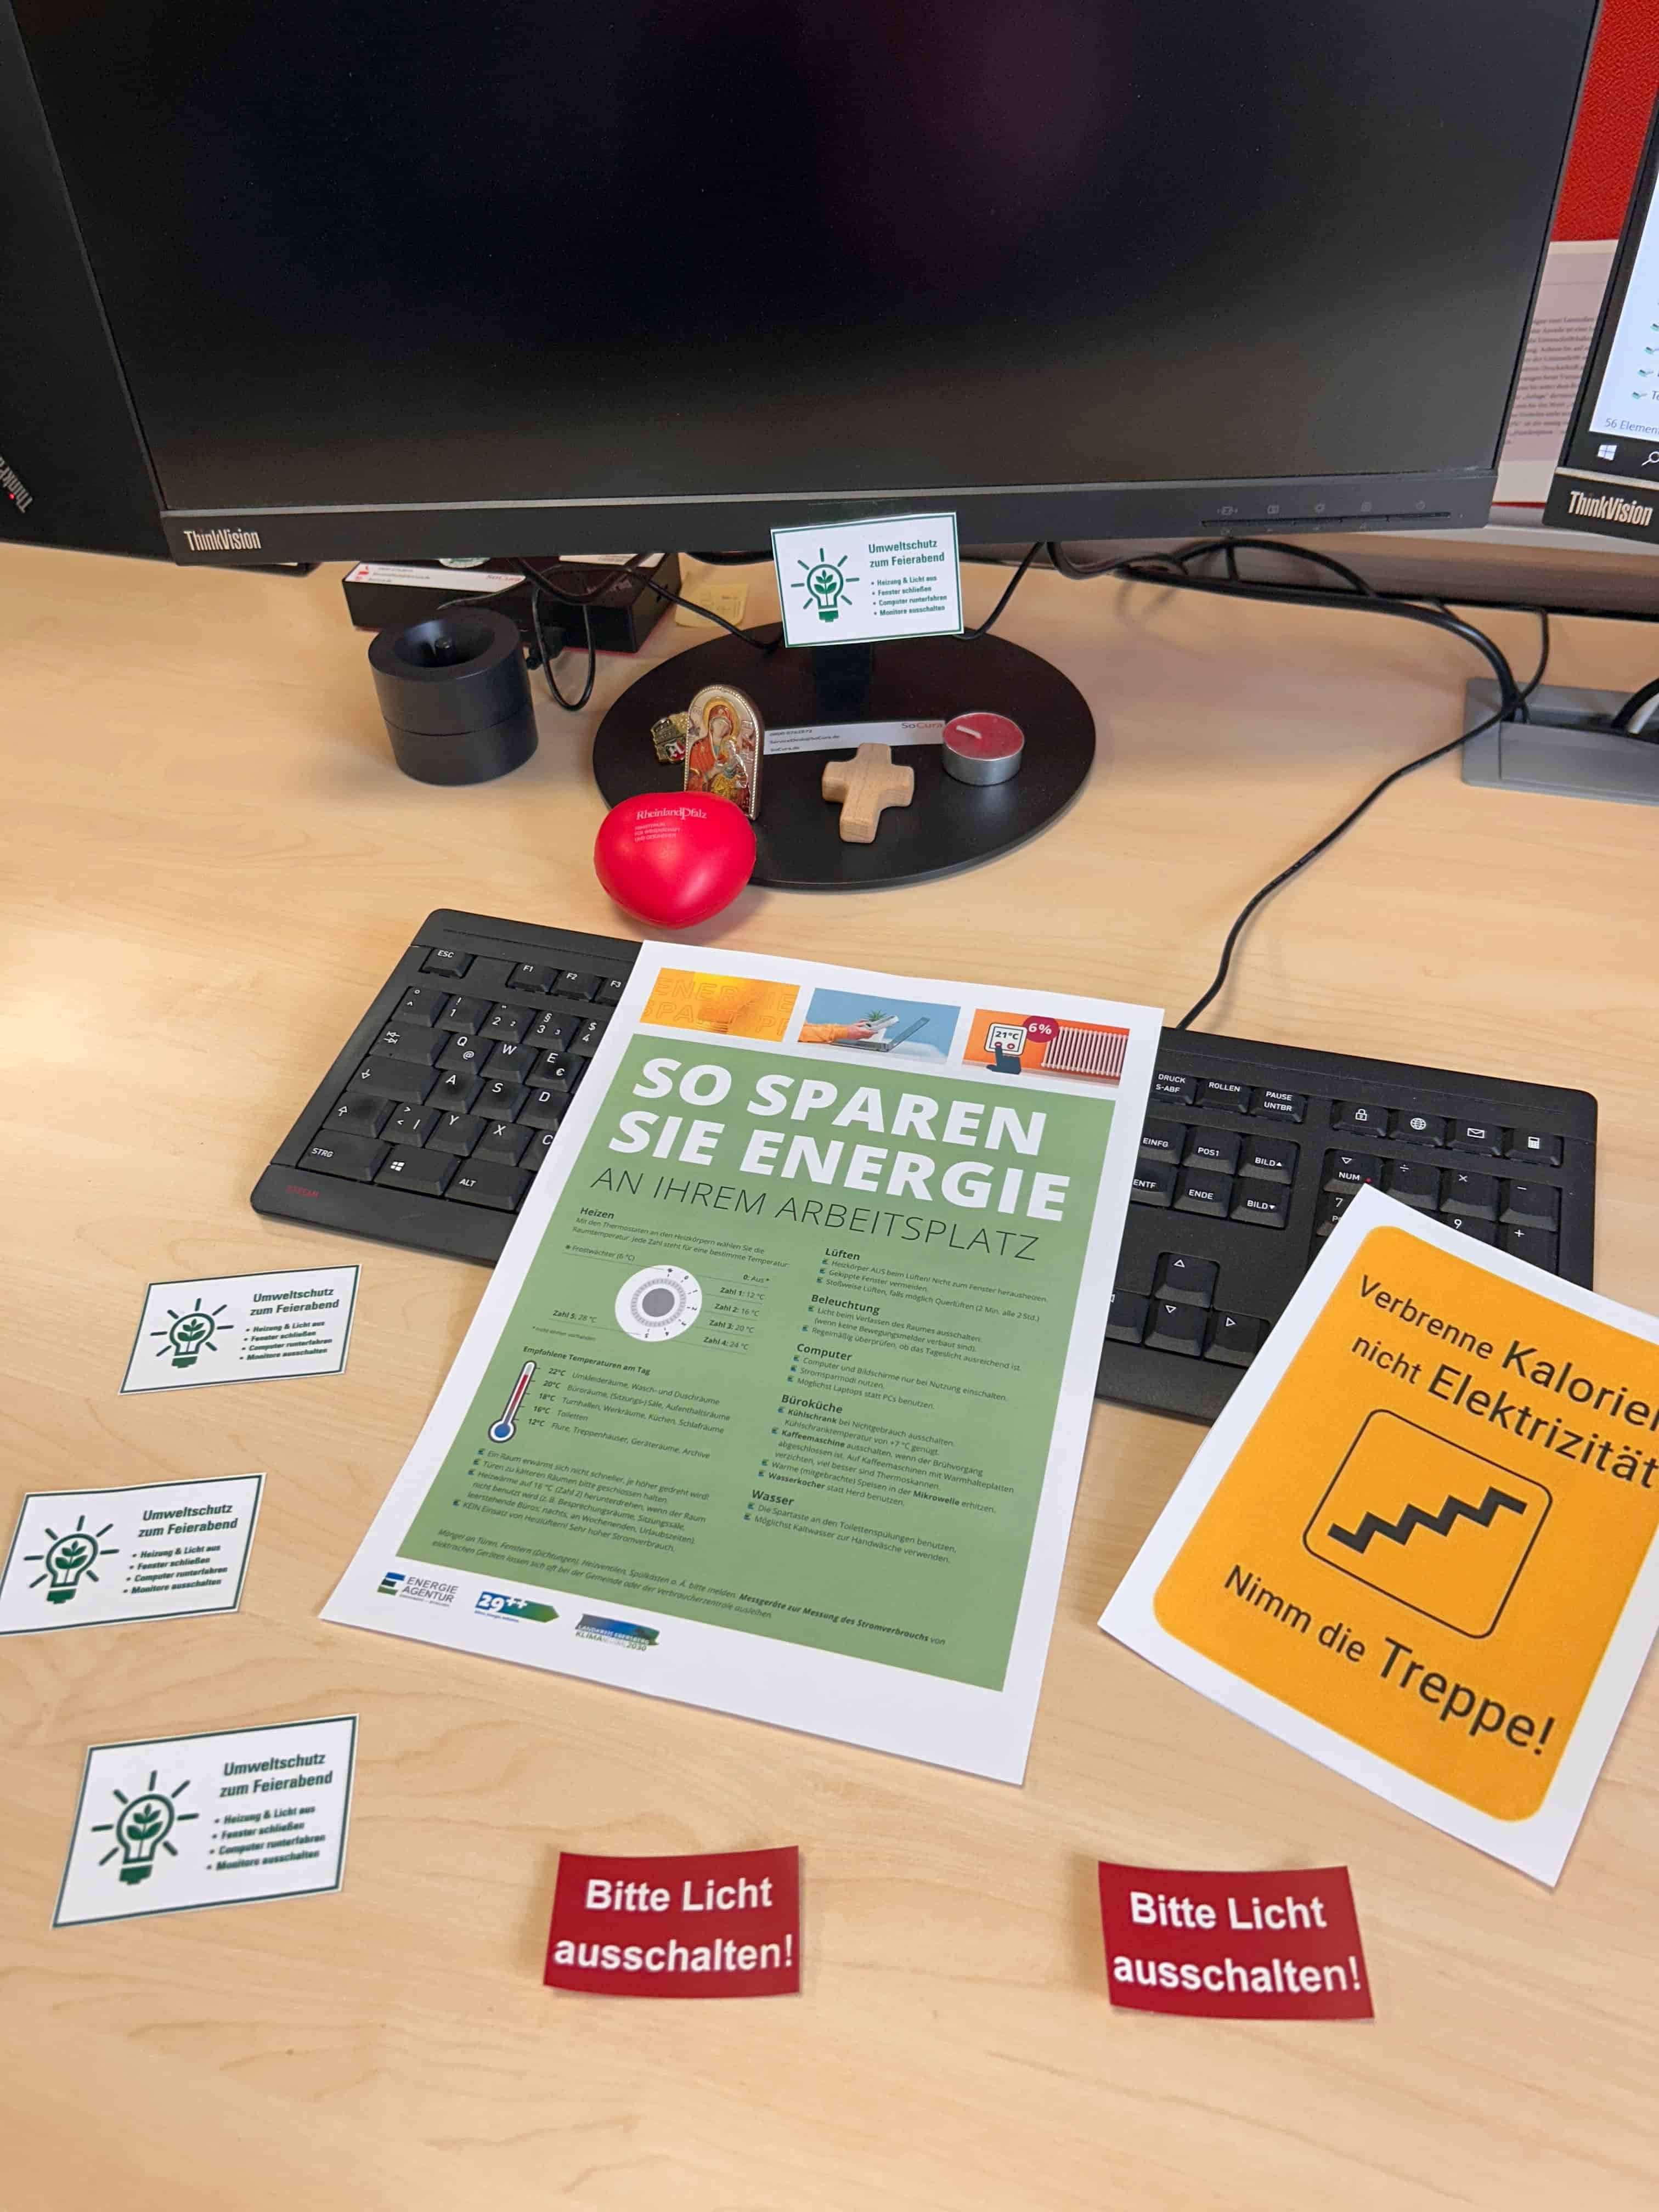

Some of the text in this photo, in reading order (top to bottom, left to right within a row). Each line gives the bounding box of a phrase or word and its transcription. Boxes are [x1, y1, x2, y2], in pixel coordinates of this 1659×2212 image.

[1605, 418, 1617, 428] 56
[1568, 491, 1654, 526] ThinkVision
[184, 528, 262, 551] ThinkVision
[869, 540, 937, 553] Umweltschutz
[891, 552, 944, 566] Feierabend
[995, 1031, 1019, 1040] 21°C
[1029, 1023, 1052, 1035] 6%
[458, 1037, 467, 1046] Q
[503, 1045, 517, 1054] W
[547, 1053, 558, 1063] E
[446, 1075, 455, 1084] A
[1158, 1074, 1185, 1086] DRUCK
[492, 1083, 503, 1092] S
[1156, 1084, 1180, 1092] S-ABF
[1209, 1082, 1240, 1092] ROLLEN
[539, 1092, 550, 1102] D
[1265, 1091, 1293, 1103] PAUSE
[631, 1057, 1048, 1157] SO SPAREN
[1264, 1102, 1292, 1111] UNTBR
[449, 1115, 459, 1125] Y
[494, 1125, 506, 1136] X
[1143, 1138, 1168, 1147] EINFG
[312, 1148, 333, 1157] STRG
[1198, 1147, 1218, 1156] POS1
[607, 1110, 1071, 1223] SIE ENERGIE
[1339, 1172, 1360, 1181] NUM
[1132, 1179, 1156, 1191] ENTF
[1189, 1189, 1213, 1199] ENDE
[1336, 1198, 1343, 1207] 7
[580, 1207, 614, 1219] Heizen
[590, 1167, 1040, 1262] AN IHREM ARBEITSPLATZ
[1454, 1219, 1462, 1228] 9
[826, 1248, 860, 1260] Lüften
[253, 1289, 334, 1302] Umweltschutz
[276, 1299, 339, 1313] Feierabend
[812, 1295, 880, 1316] Beleuchtung
[1360, 1275, 1494, 1359] Verbrenne
[286, 1339, 332, 1347] runterfahren
[283, 1348, 327, 1357] ausschalten
[797, 1344, 853, 1361] Computer
[523, 1346, 567, 1359] Empfohlene
[569, 1355, 622, 1369] Temperaturen
[638, 1367, 650, 1376] Tag
[803, 1357, 839, 1369] Computer
[857, 1368, 900, 1380] Bildschirme
[930, 1381, 961, 1393] Nutzung
[782, 1395, 843, 1413] Büroküche
[1351, 1336, 1659, 1488] nicht Elektrizität
[788, 1409, 836, 1424] Kühlschrank
[853, 1421, 906, 1437] Nichtgebrauch
[782, 1430, 845, 1447] Kaffeemaschine
[933, 1460, 983, 1477] Brühvorgang
[769, 1472, 825, 1488] Wasserkocher
[846, 1488, 865, 1497] Herd
[753, 1489, 794, 1505] Wasser
[143, 1505, 233, 1521] Umweltschutz
[138, 1518, 238, 1537] zum Feierabend
[170, 1558, 210, 1567] schließen
[134, 1567, 228, 1582] Computer runterfahren
[131, 1579, 221, 1594] Monitore ausschalten
[407, 1577, 458, 1594] ENERGIE
[402, 1586, 454, 1602] AGENTUR
[1224, 1564, 1555, 1756] Nimm die Treppe!
[224, 1754, 325, 1776] Umweltschutz
[219, 1771, 332, 1797] zum Feierabend
[224, 1814, 261, 1824] Heizung
[263, 1810, 270, 1819] &
[274, 1808, 297, 1818] Licht
[222, 1821, 304, 1839] Fenster schließen
[219, 1835, 325, 1855] Computer runterfahren
[216, 1851, 319, 1870] Monitore ausschalten
[585, 1877, 772, 1911] Bitte Licht
[1130, 1891, 1327, 1929] Bitte Licht
[553, 1934, 793, 1972] ausschalten!
[1113, 1955, 1361, 1993] ausschalten!
